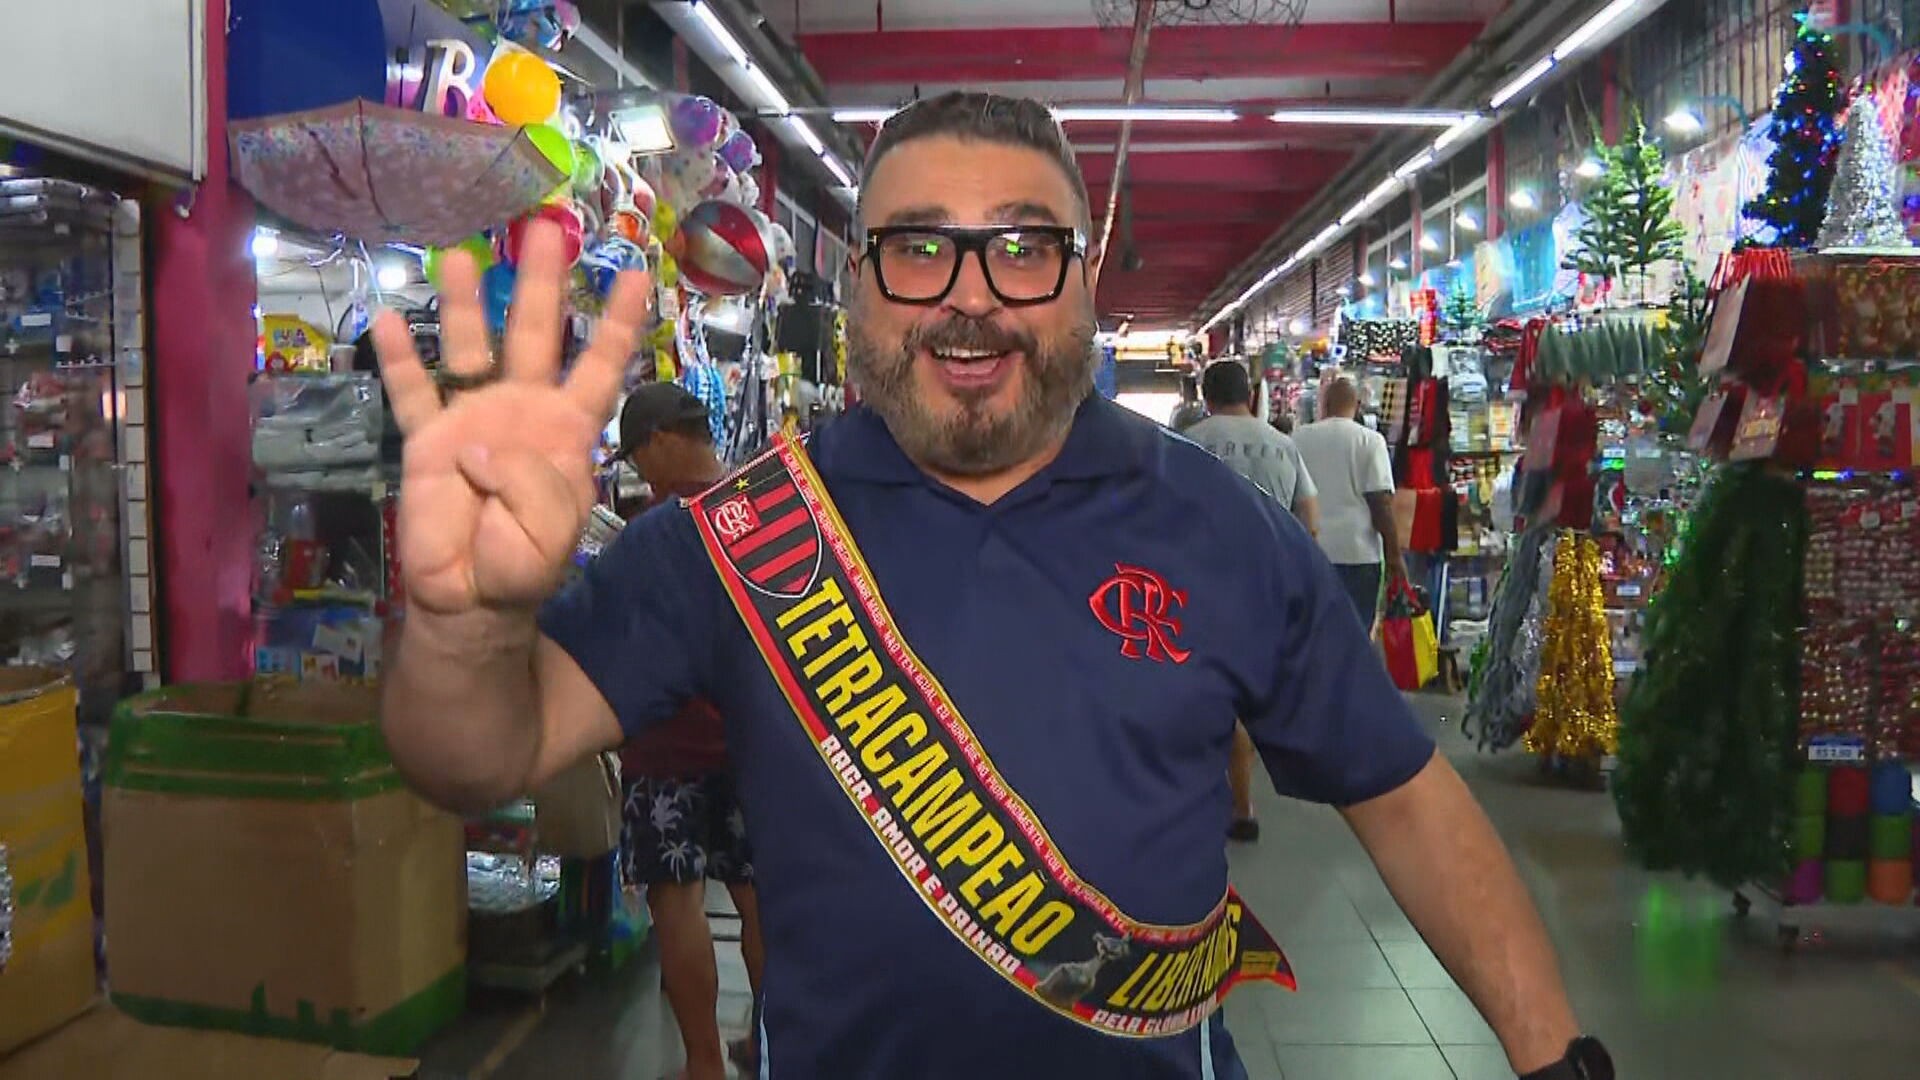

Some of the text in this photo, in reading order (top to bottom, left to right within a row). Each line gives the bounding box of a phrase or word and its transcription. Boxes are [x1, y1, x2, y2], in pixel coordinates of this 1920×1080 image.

[775, 577, 1075, 955] TETRACAMPEÃO
[872, 807, 927, 875] AMOR
[923, 874, 942, 894] E
[1091, 1008, 1142, 1033] PELA
